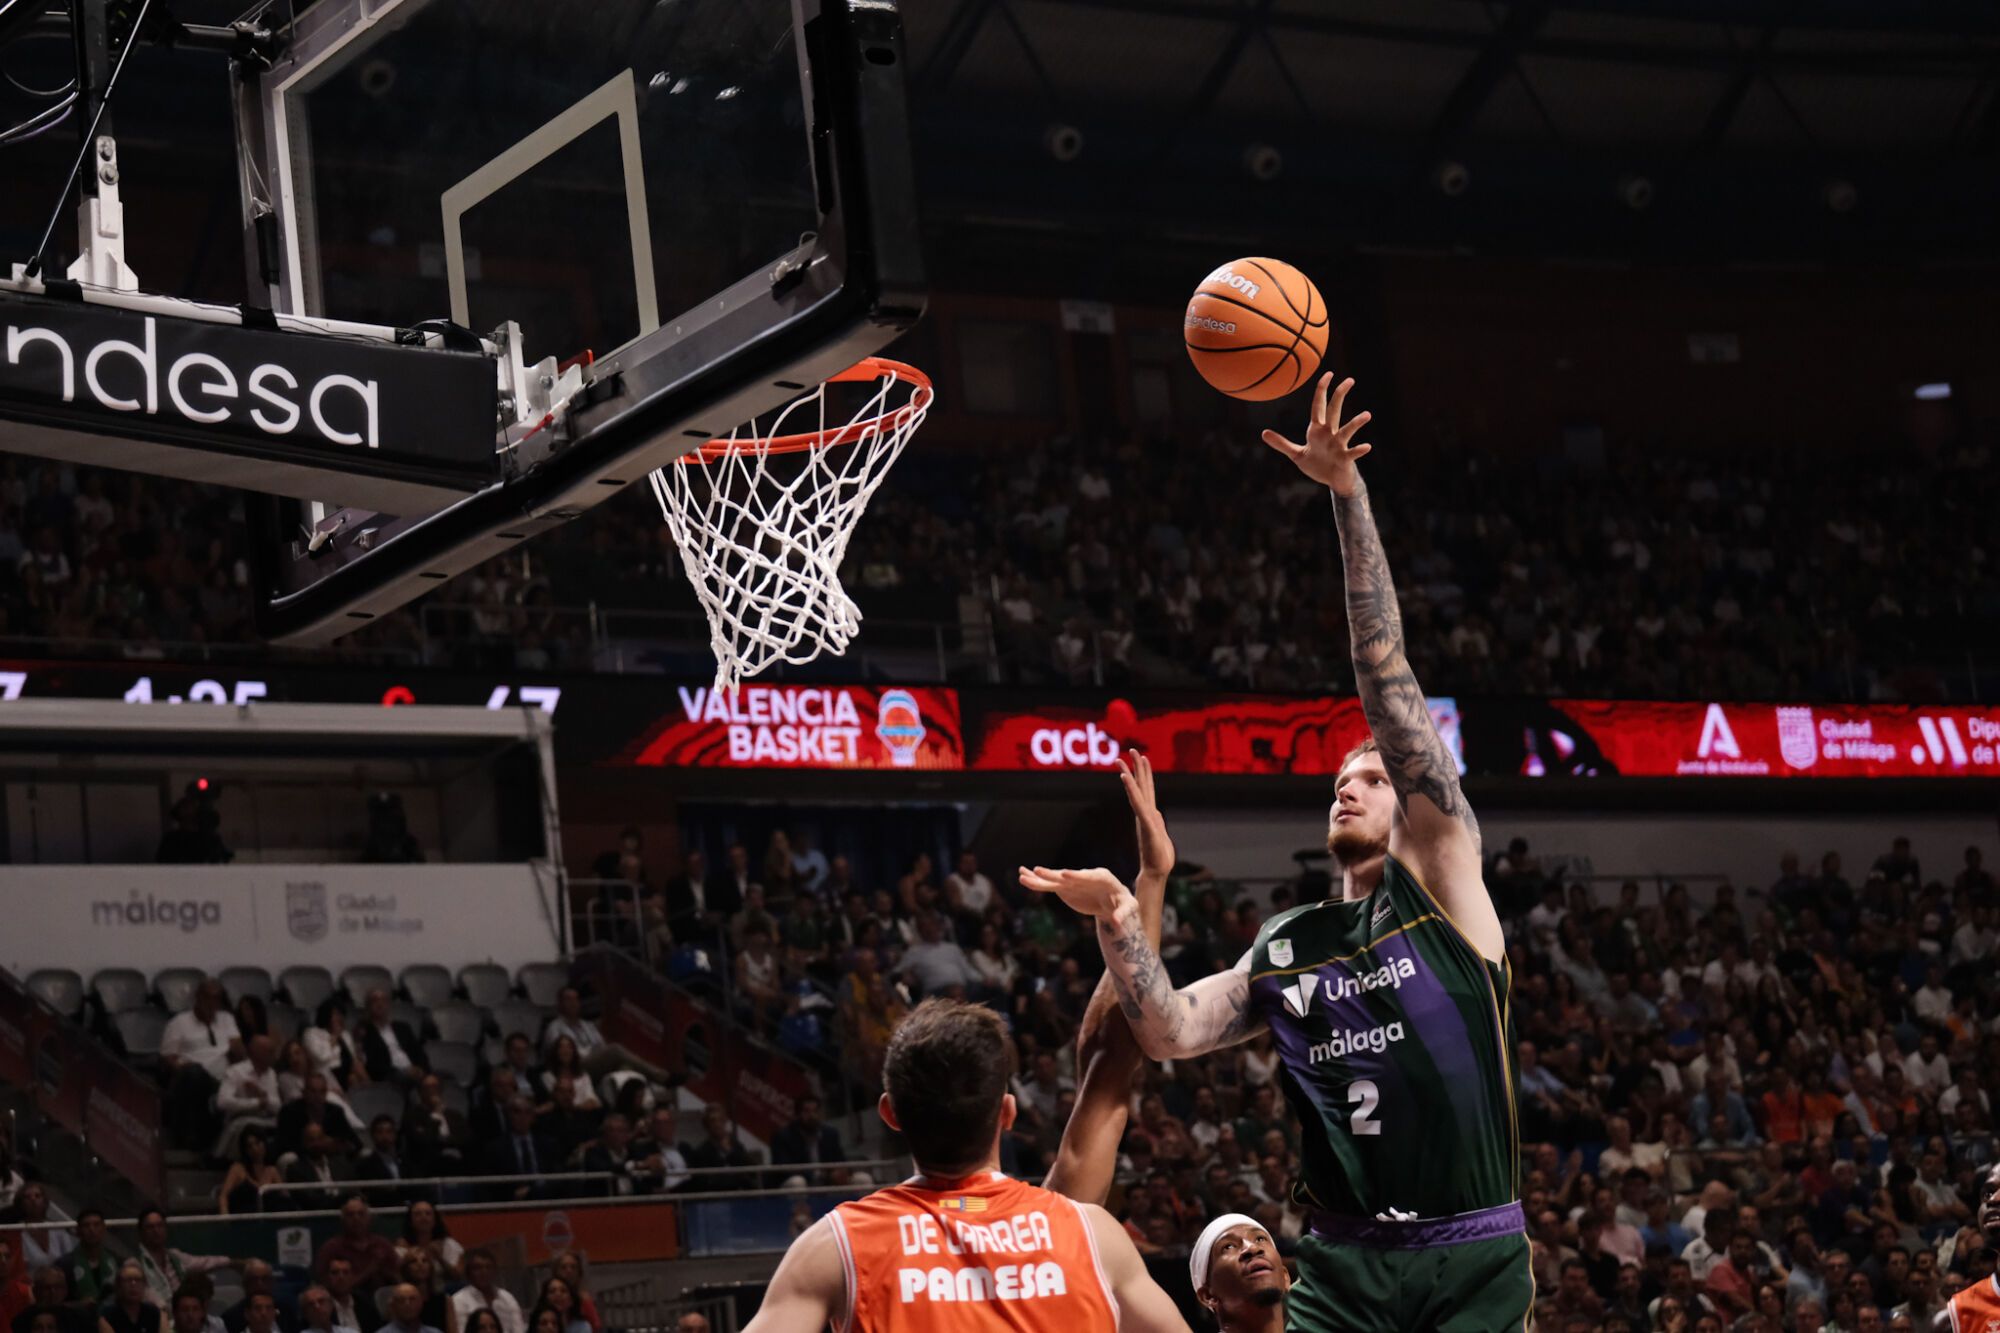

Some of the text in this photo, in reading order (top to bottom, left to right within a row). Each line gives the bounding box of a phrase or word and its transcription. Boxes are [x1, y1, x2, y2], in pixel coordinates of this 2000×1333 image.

[677, 685, 862, 726] VALENCIA
[727, 725, 862, 762] BASKET
[1030, 721, 1120, 766] acb
[1819, 719, 1872, 738] Ciudad
[1823, 740, 1842, 759] de
[1324, 957, 1417, 1001] Unicaja
[1347, 1080, 1382, 1136] 2
[898, 1211, 1054, 1256] DE LARREA
[898, 1261, 1067, 1303] PAMESA
